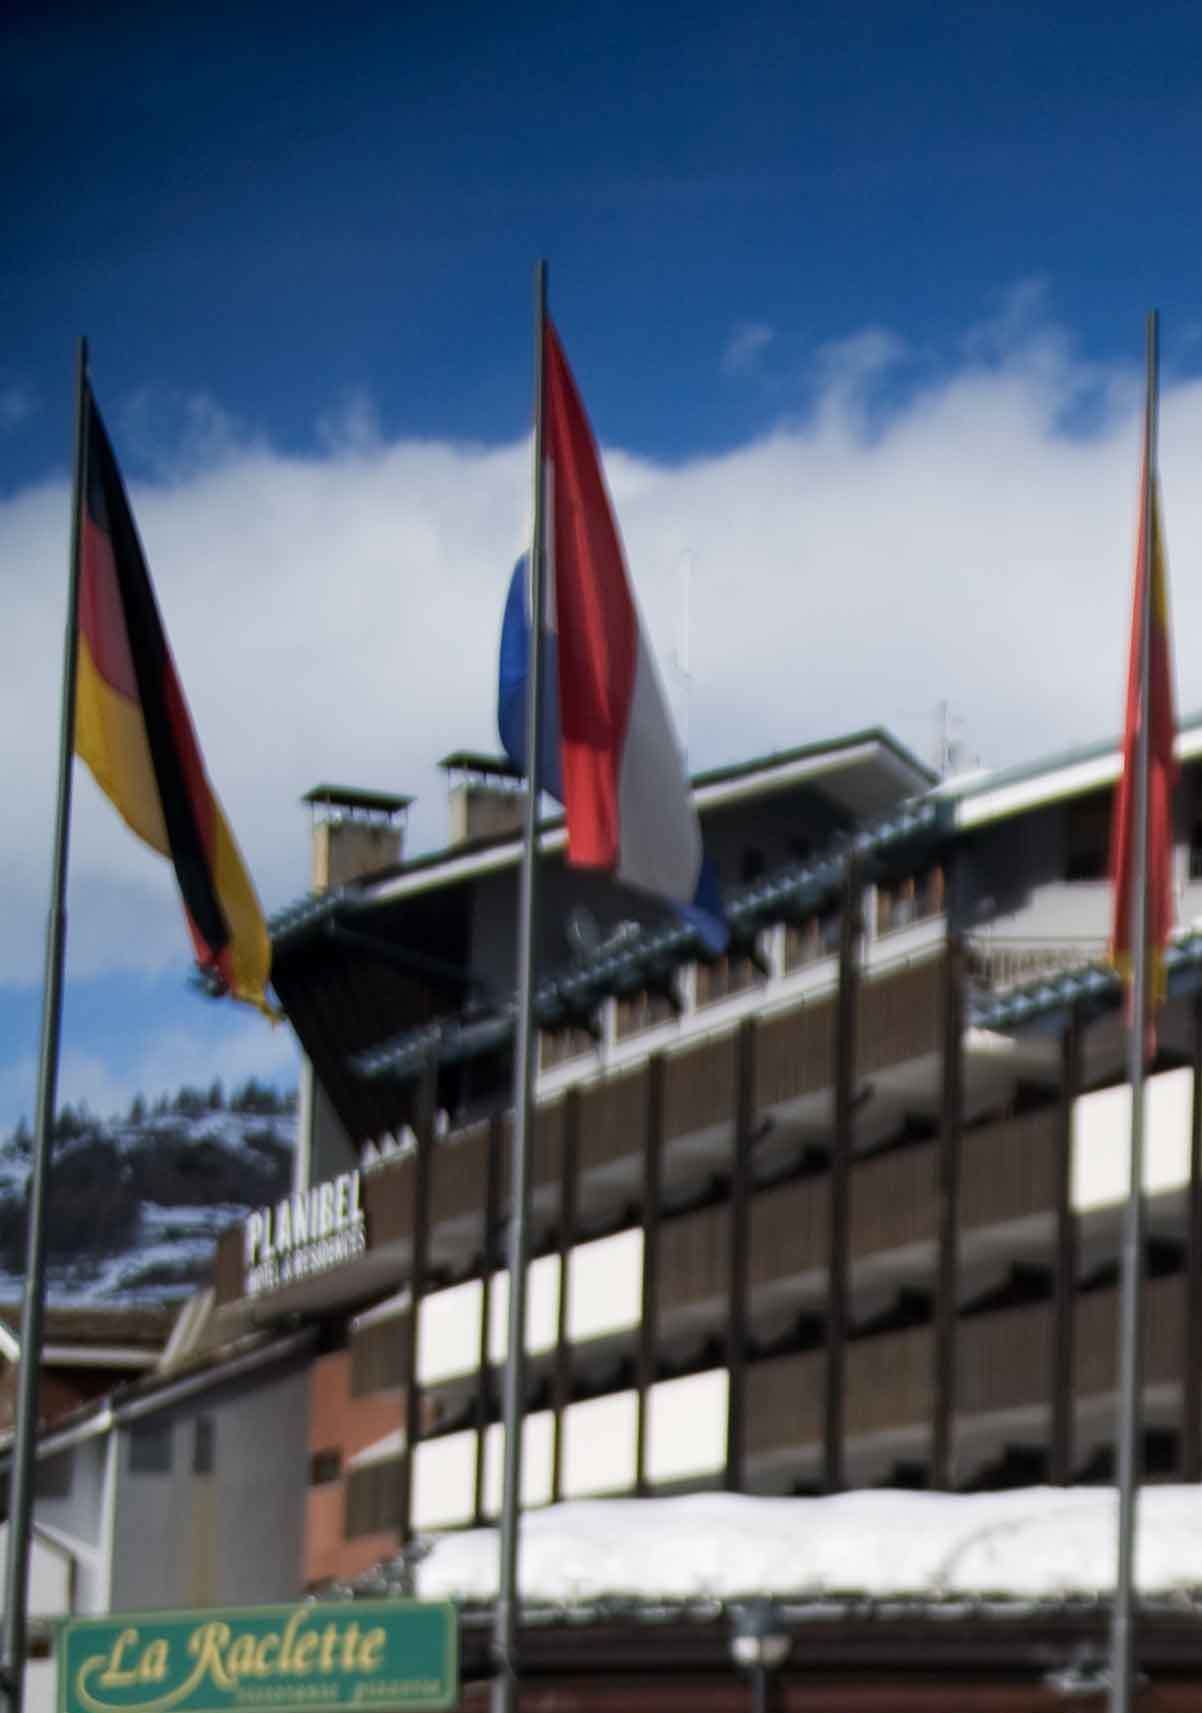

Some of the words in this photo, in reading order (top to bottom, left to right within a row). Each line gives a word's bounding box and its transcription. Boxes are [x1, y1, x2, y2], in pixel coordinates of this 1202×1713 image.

[244, 1168, 365, 1266] PLANIBEL
[101, 1627, 170, 1688] La
[187, 1604, 388, 1692] Raclette
